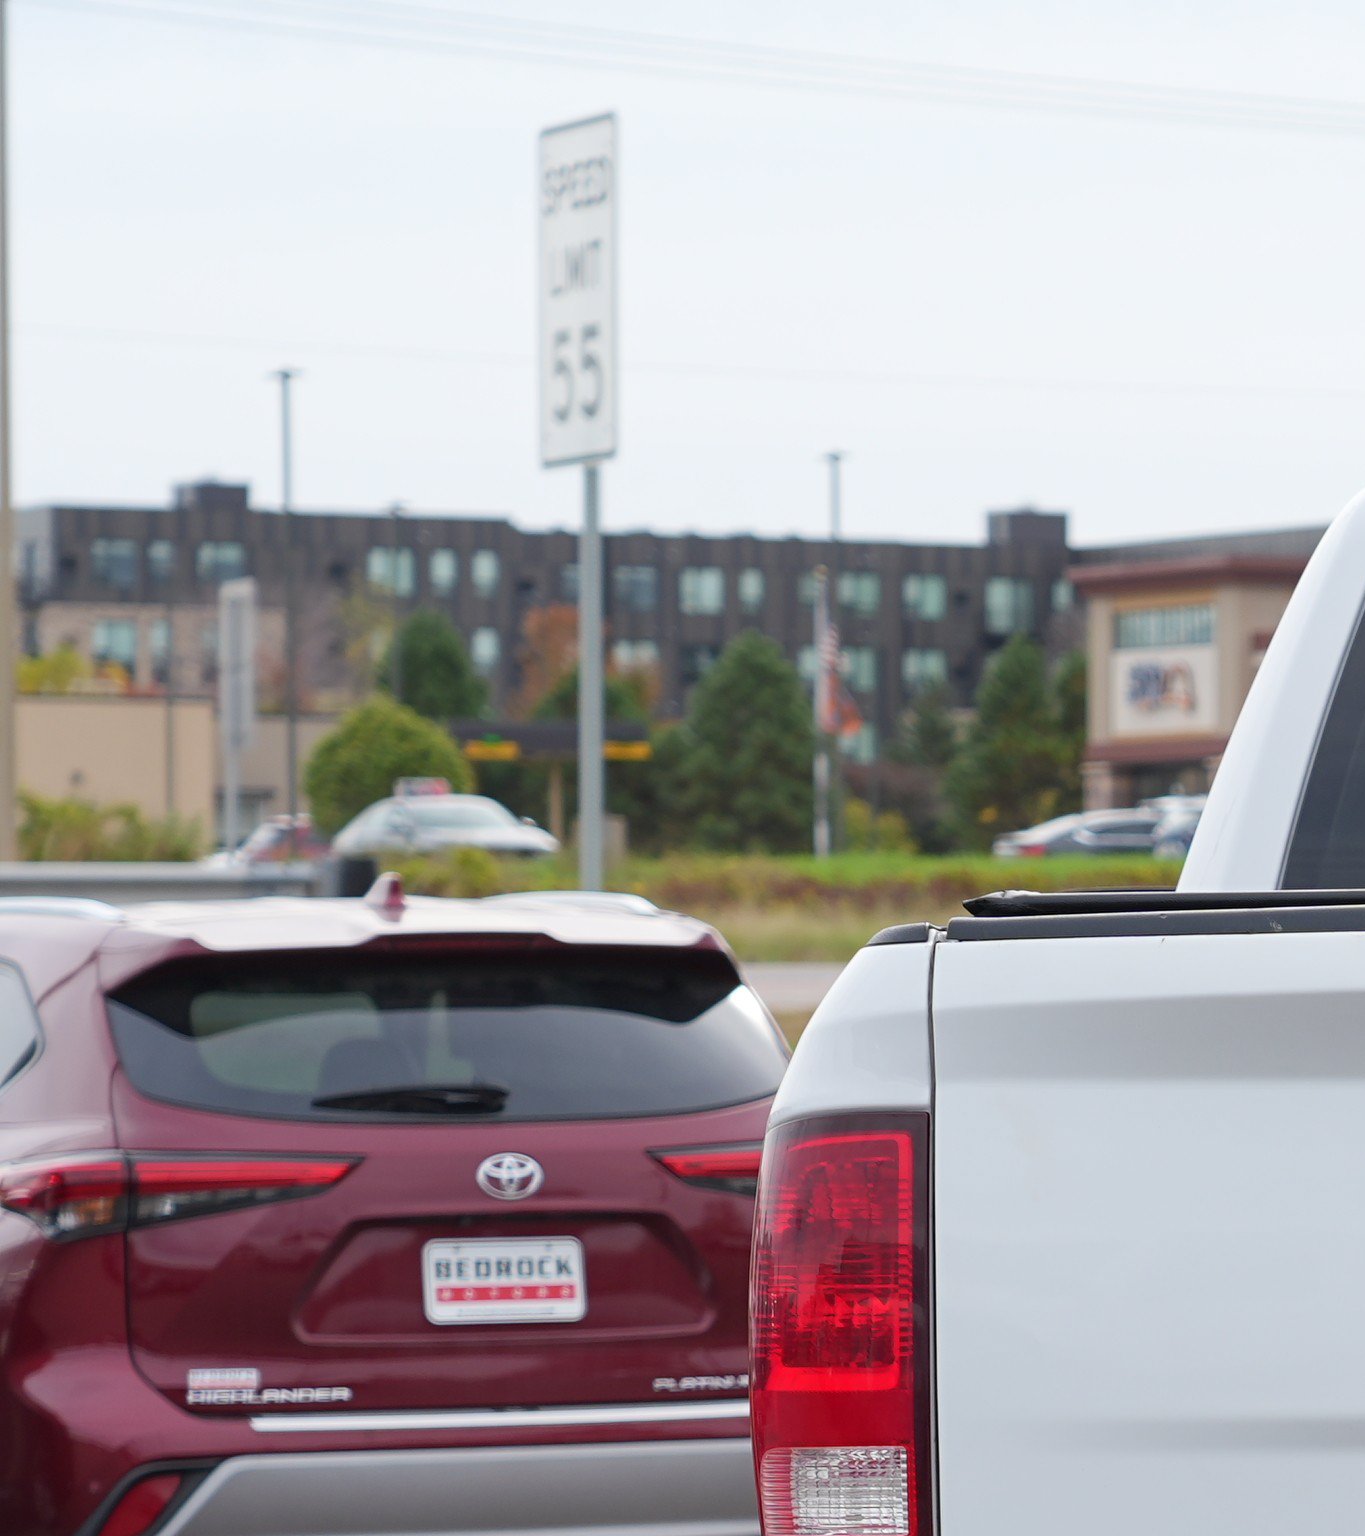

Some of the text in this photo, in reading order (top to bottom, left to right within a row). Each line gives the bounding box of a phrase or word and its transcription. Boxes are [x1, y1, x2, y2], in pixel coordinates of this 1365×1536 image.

[543, 156, 608, 216] SPEED
[551, 238, 603, 297] LIMIT
[553, 323, 604, 422] 55
[435, 1257, 573, 1280] BEDROCK
